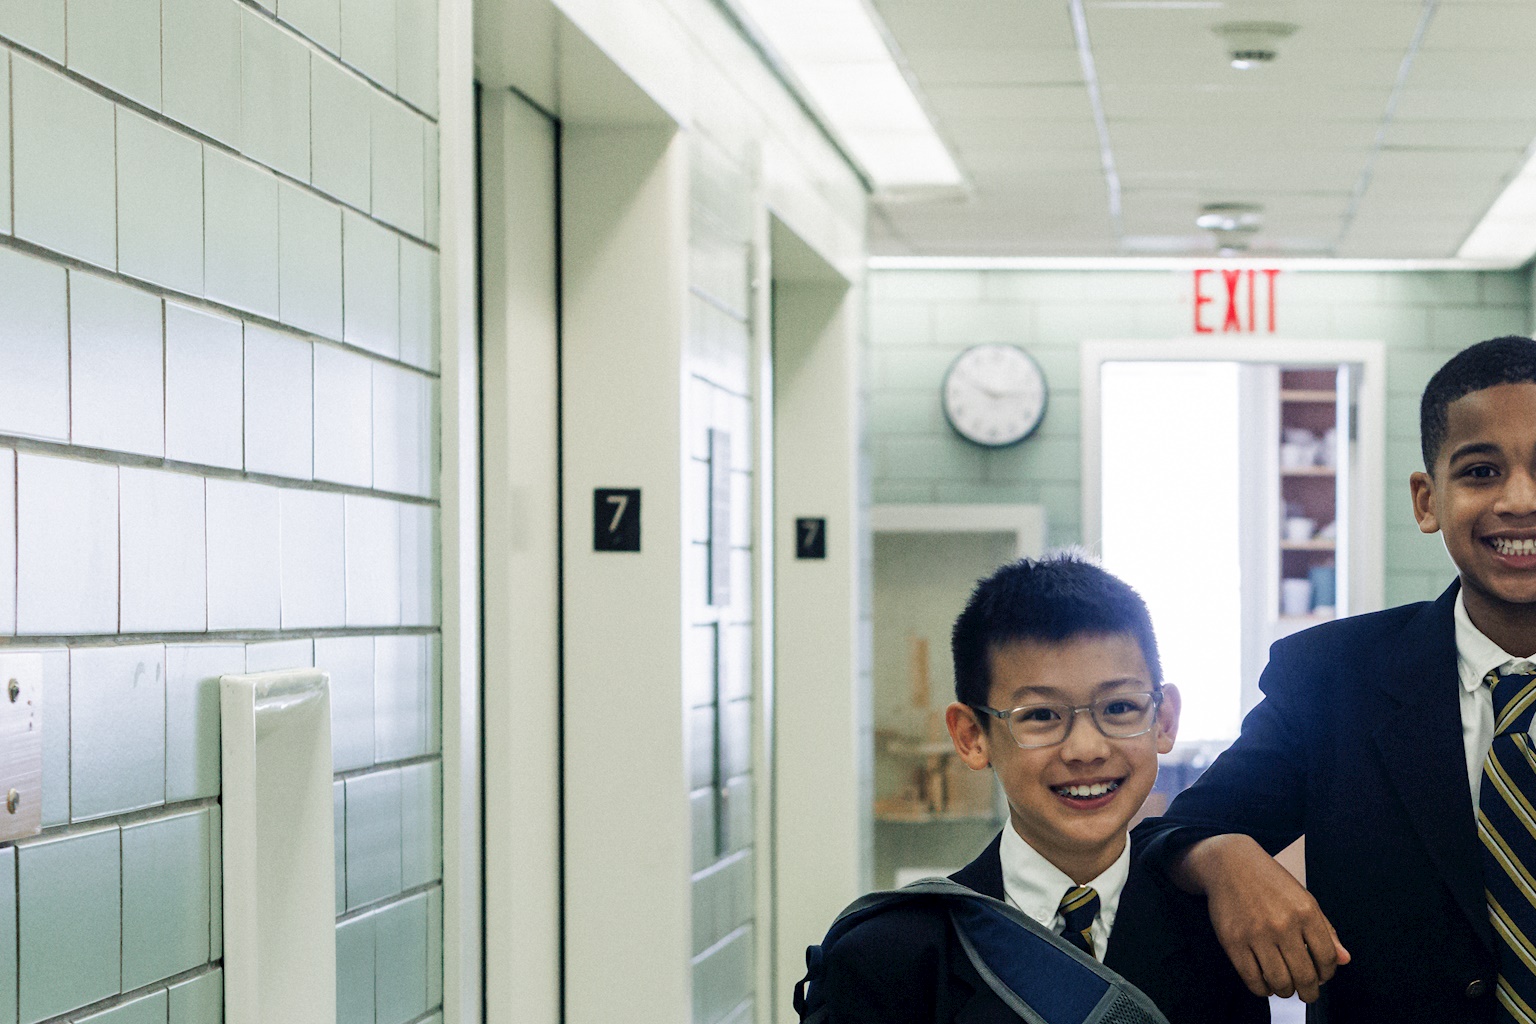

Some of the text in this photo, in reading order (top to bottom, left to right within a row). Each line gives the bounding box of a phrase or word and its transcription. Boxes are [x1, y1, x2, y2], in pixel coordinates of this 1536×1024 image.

[1194, 269, 1281, 333] EXIT
[606, 495, 628, 532] 7
[801, 521, 819, 547] 7
